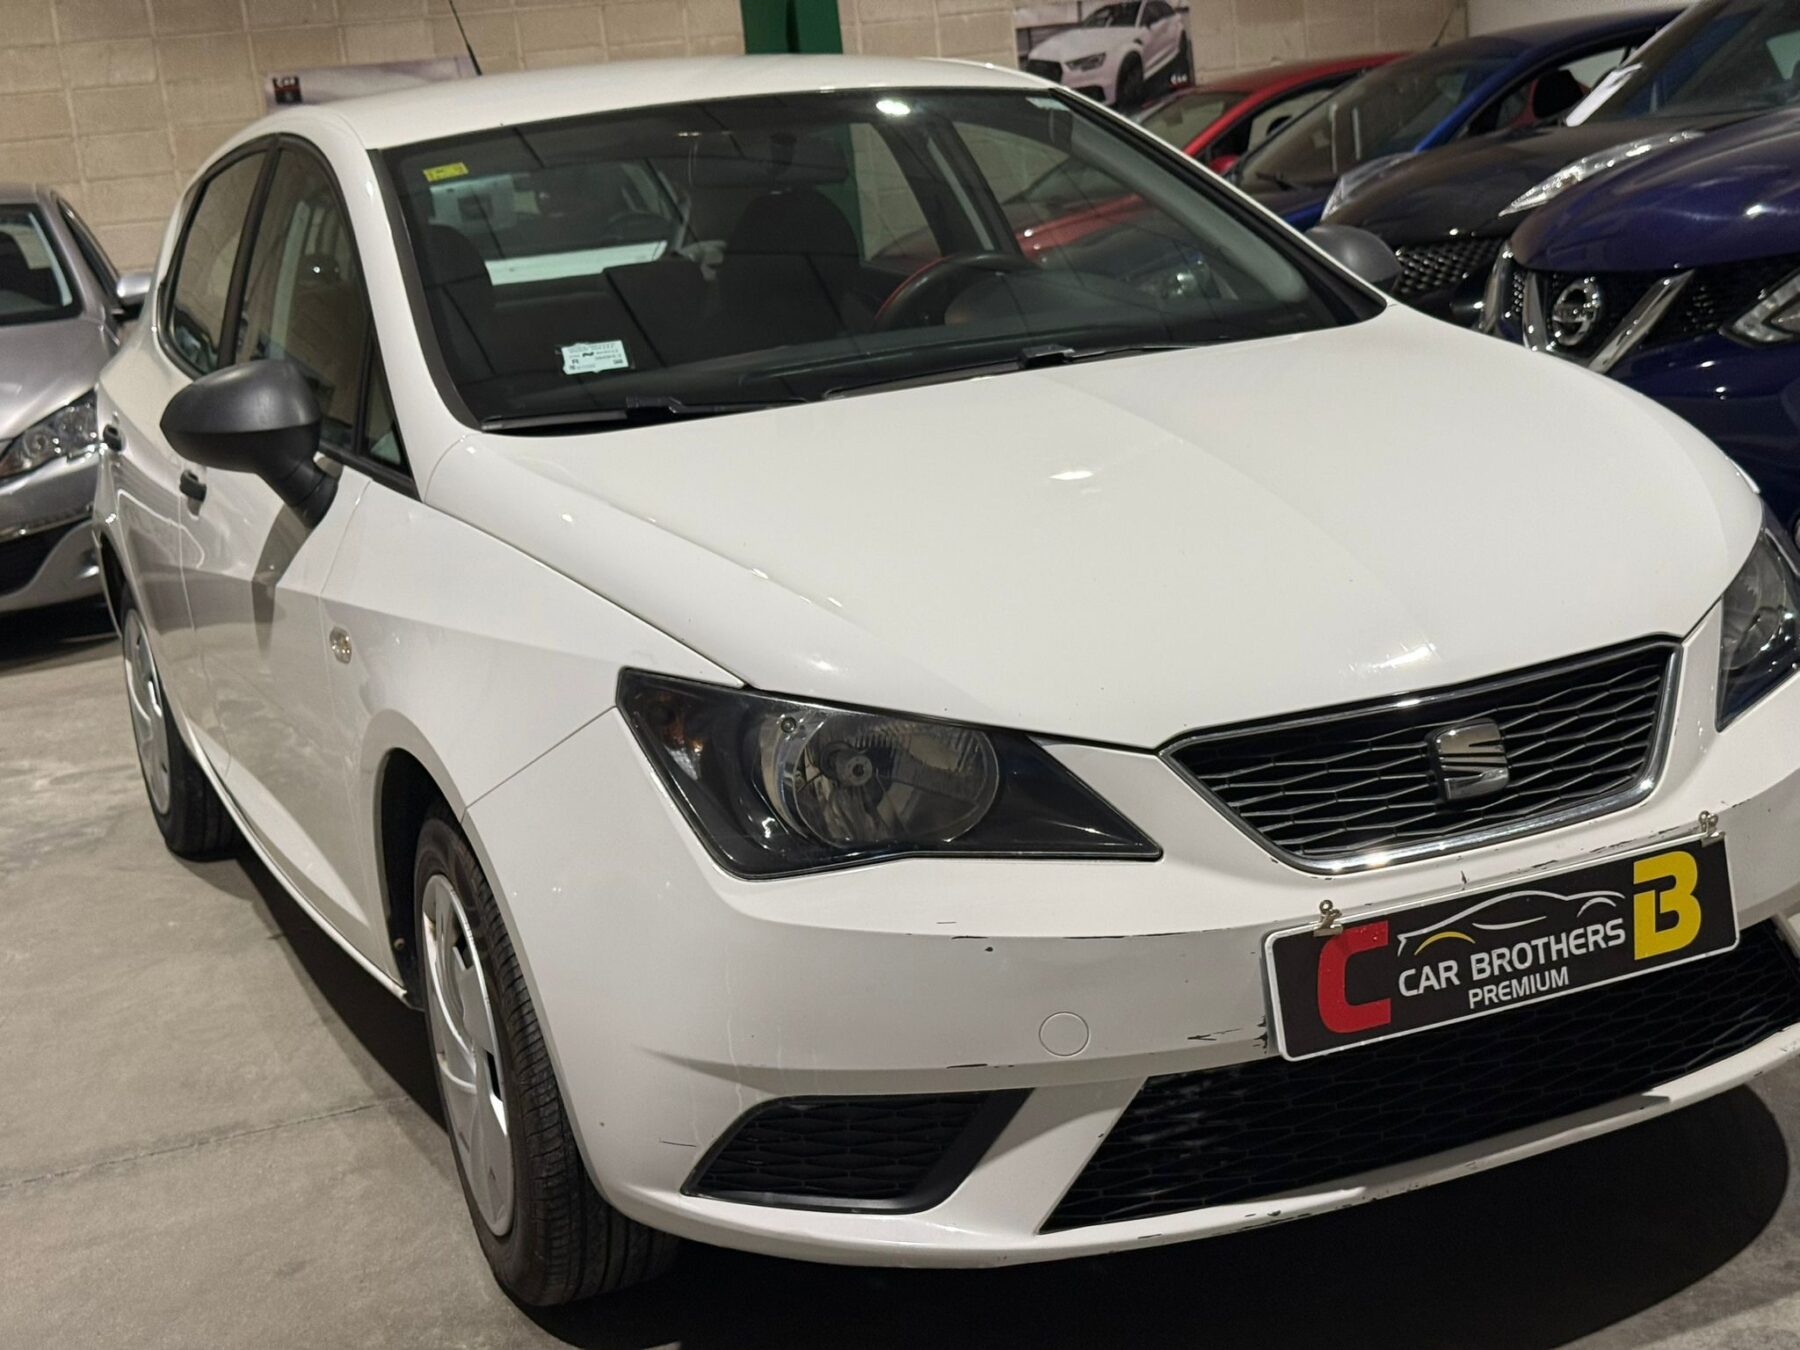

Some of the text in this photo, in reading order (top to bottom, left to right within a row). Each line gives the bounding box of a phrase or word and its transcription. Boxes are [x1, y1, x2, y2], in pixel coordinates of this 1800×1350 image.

[1633, 850, 1702, 961] B
[1317, 920, 1391, 1034] C
[1398, 917, 1626, 997] CAR BROTHERS
[1468, 966, 1570, 1010] PREMIUM
